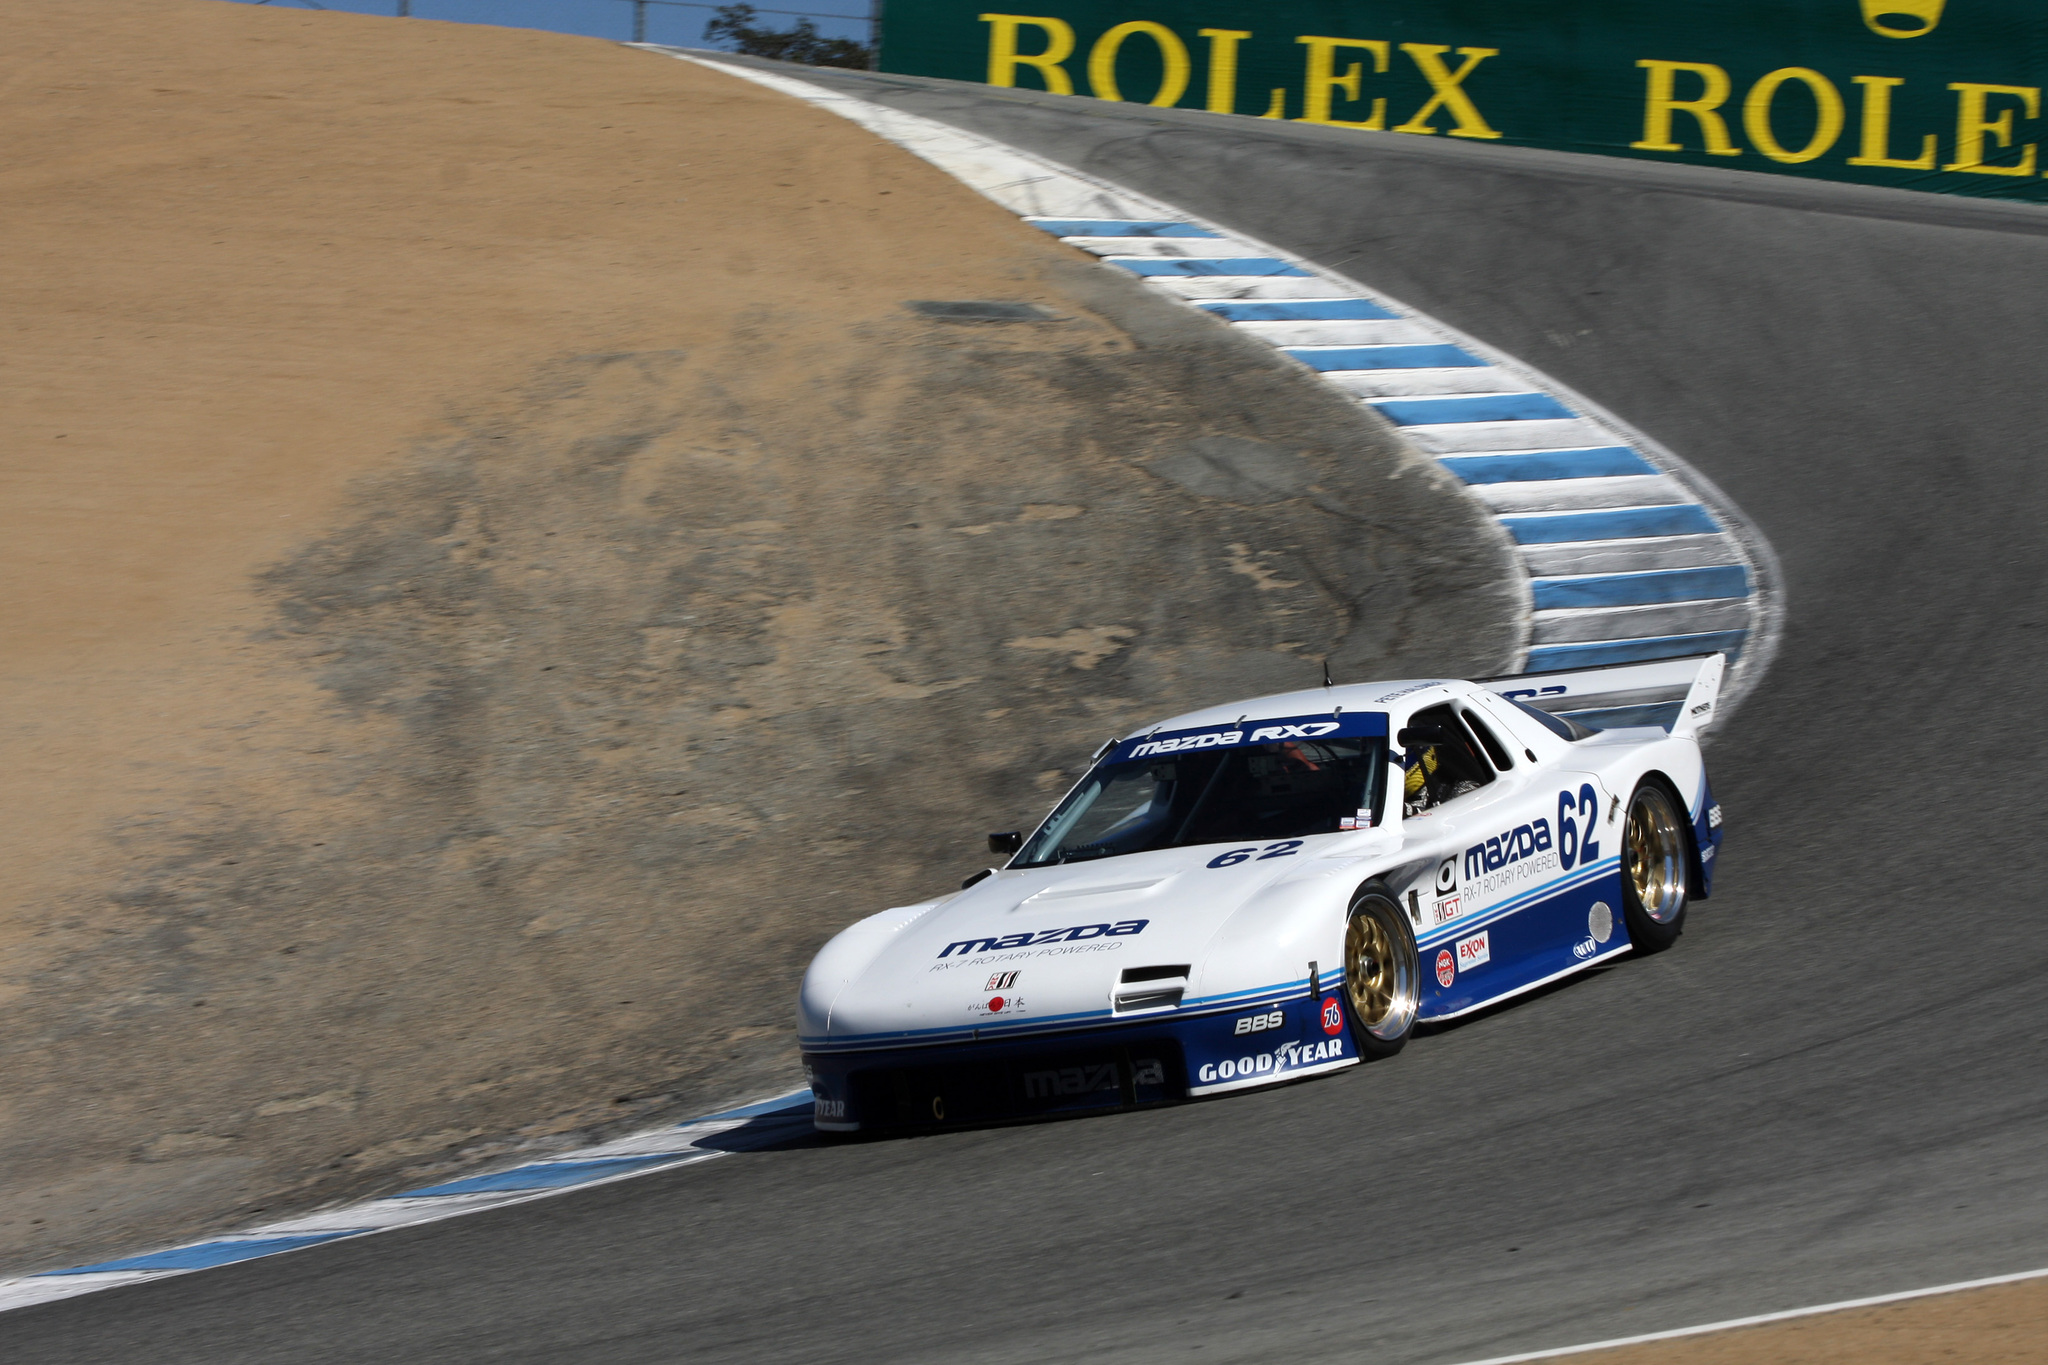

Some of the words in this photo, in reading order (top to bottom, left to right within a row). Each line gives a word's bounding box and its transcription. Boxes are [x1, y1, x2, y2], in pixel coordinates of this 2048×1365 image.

[977, 12, 1502, 139] ROLEX
[1632, 58, 2048, 179] ROLE
[1250, 722, 1340, 741] RX7
[1557, 783, 1600, 871] 62
[1206, 840, 1304, 869] 62
[1463, 881, 1481, 902] RX-7
[1483, 868, 1516, 894] ROTARY
[1517, 852, 1558, 880] POWERED
[929, 959, 968, 972] RX-7
[968, 950, 1034, 966] ROTARY
[1036, 942, 1122, 958] POWERED
[1460, 936, 1485, 958] EXXON
[1438, 958, 1451, 968] NGK
[1234, 1010, 1283, 1036] BBS
[1324, 1003, 1341, 1029] 76
